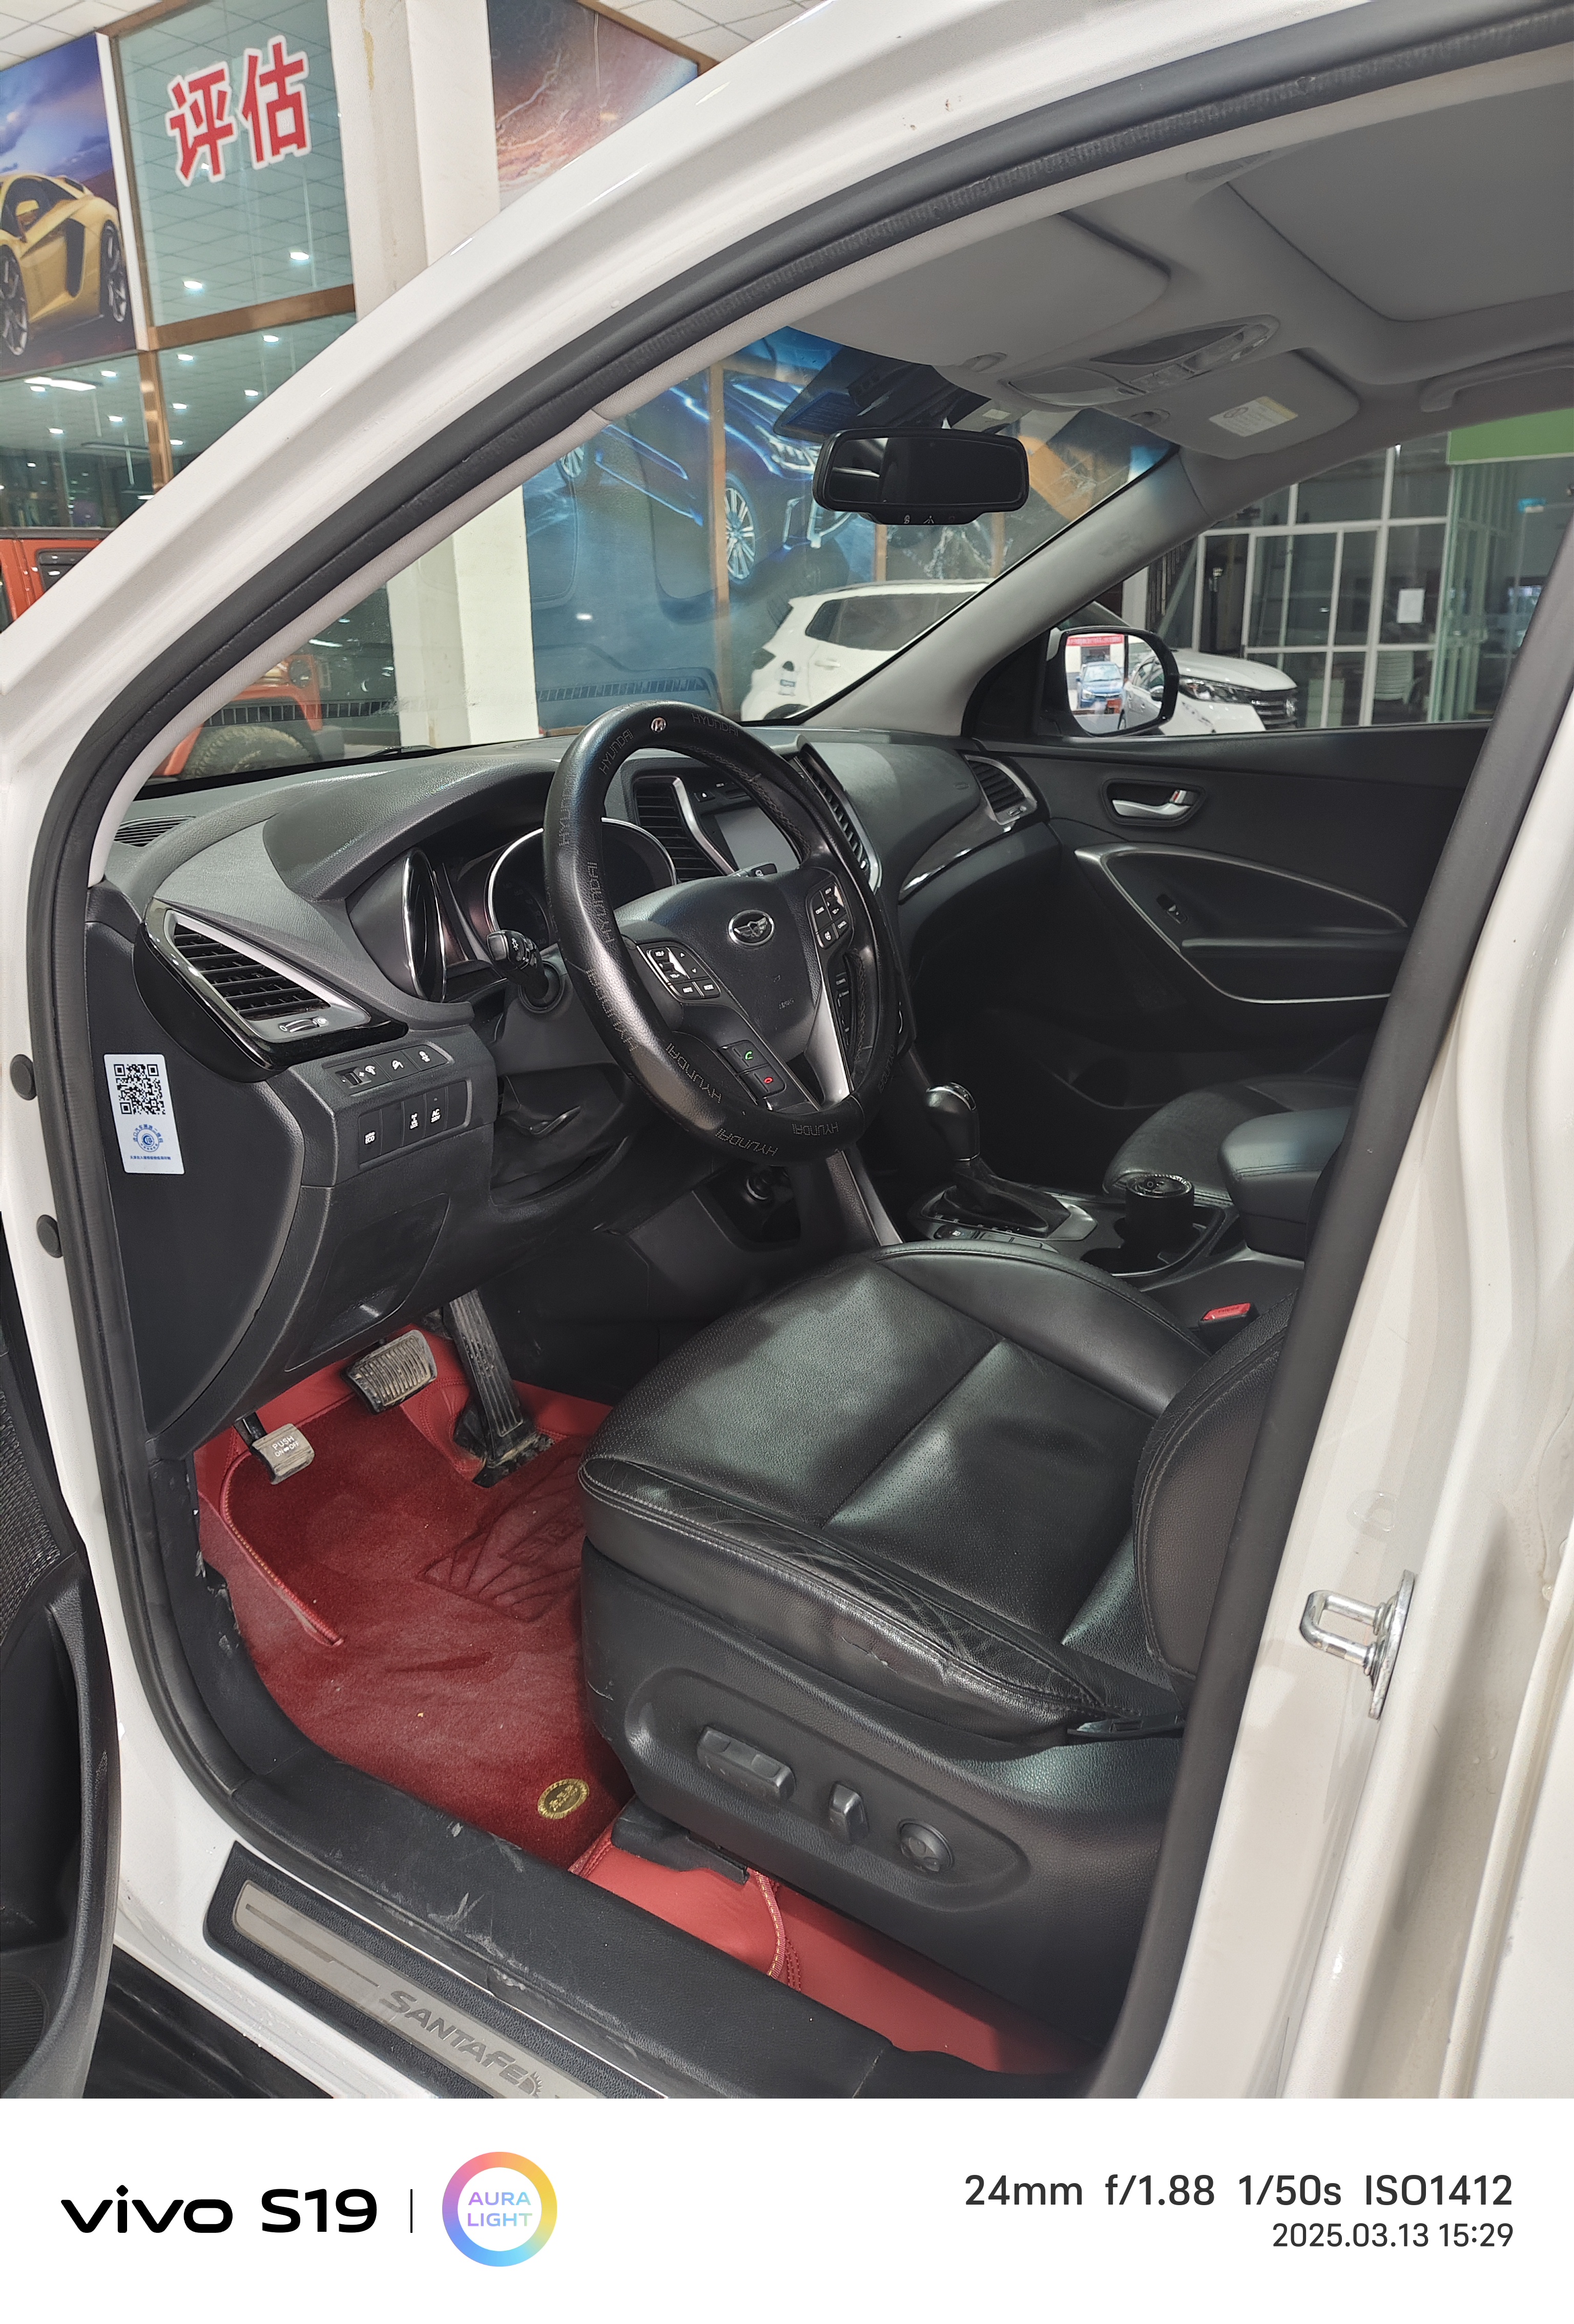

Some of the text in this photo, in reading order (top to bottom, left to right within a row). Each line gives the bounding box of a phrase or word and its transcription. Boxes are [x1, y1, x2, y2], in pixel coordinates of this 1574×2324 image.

[168, 37, 310, 184] 评估
[691, 713, 739, 737] HYUNDAI
[599, 729, 634, 775] HYUNDAI
[587, 862, 615, 943] HYUNDAI
[666, 1043, 722, 1104] HYUNDAI
[432, 1109, 440, 1117] AC
[715, 1128, 778, 1156] HYUNDAI
[792, 1122, 839, 1136] HYUNDAI
[272, 1436, 294, 1450] PUSH
[289, 1441, 299, 1450] OFF
